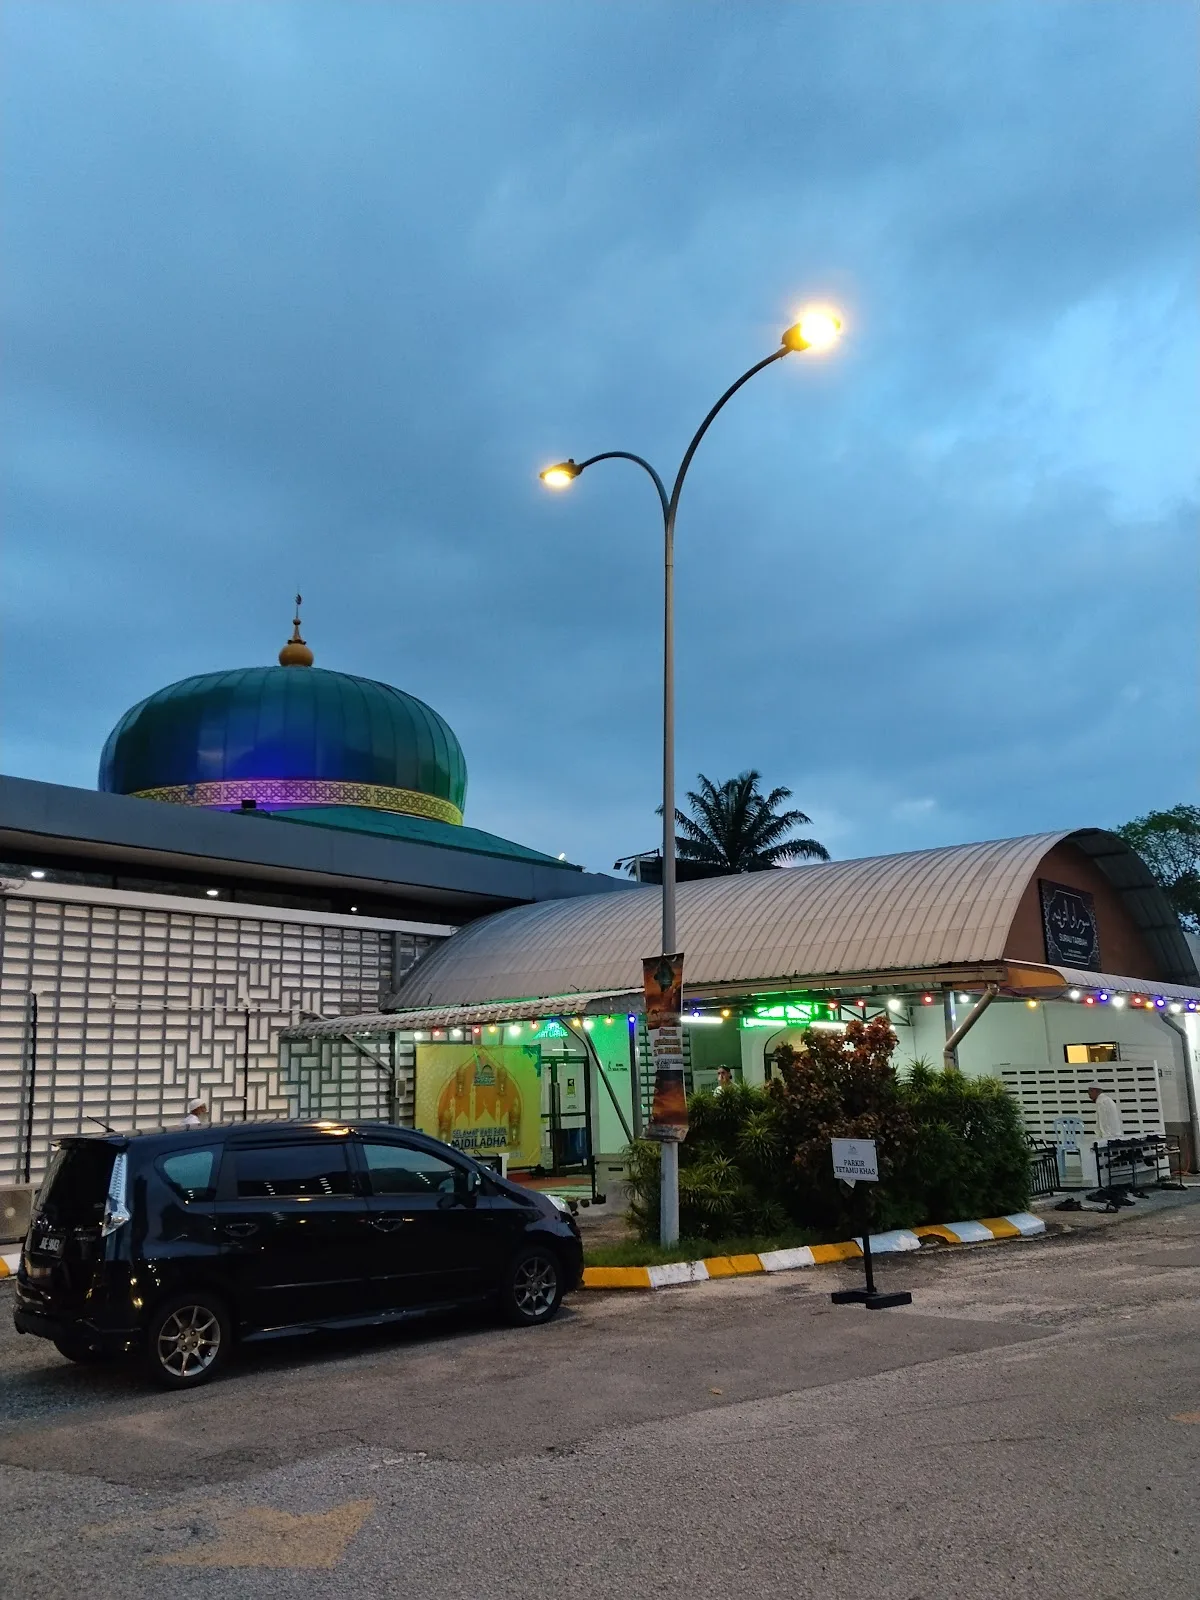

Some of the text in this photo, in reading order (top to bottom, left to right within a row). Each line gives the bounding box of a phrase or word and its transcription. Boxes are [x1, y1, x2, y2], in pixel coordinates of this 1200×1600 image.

[1059, 933, 1072, 943] SURAU
[453, 1129, 479, 1137] SELAMAT
[843, 1159, 865, 1167] PARKIR
[835, 1166, 859, 1174] TETAMU
